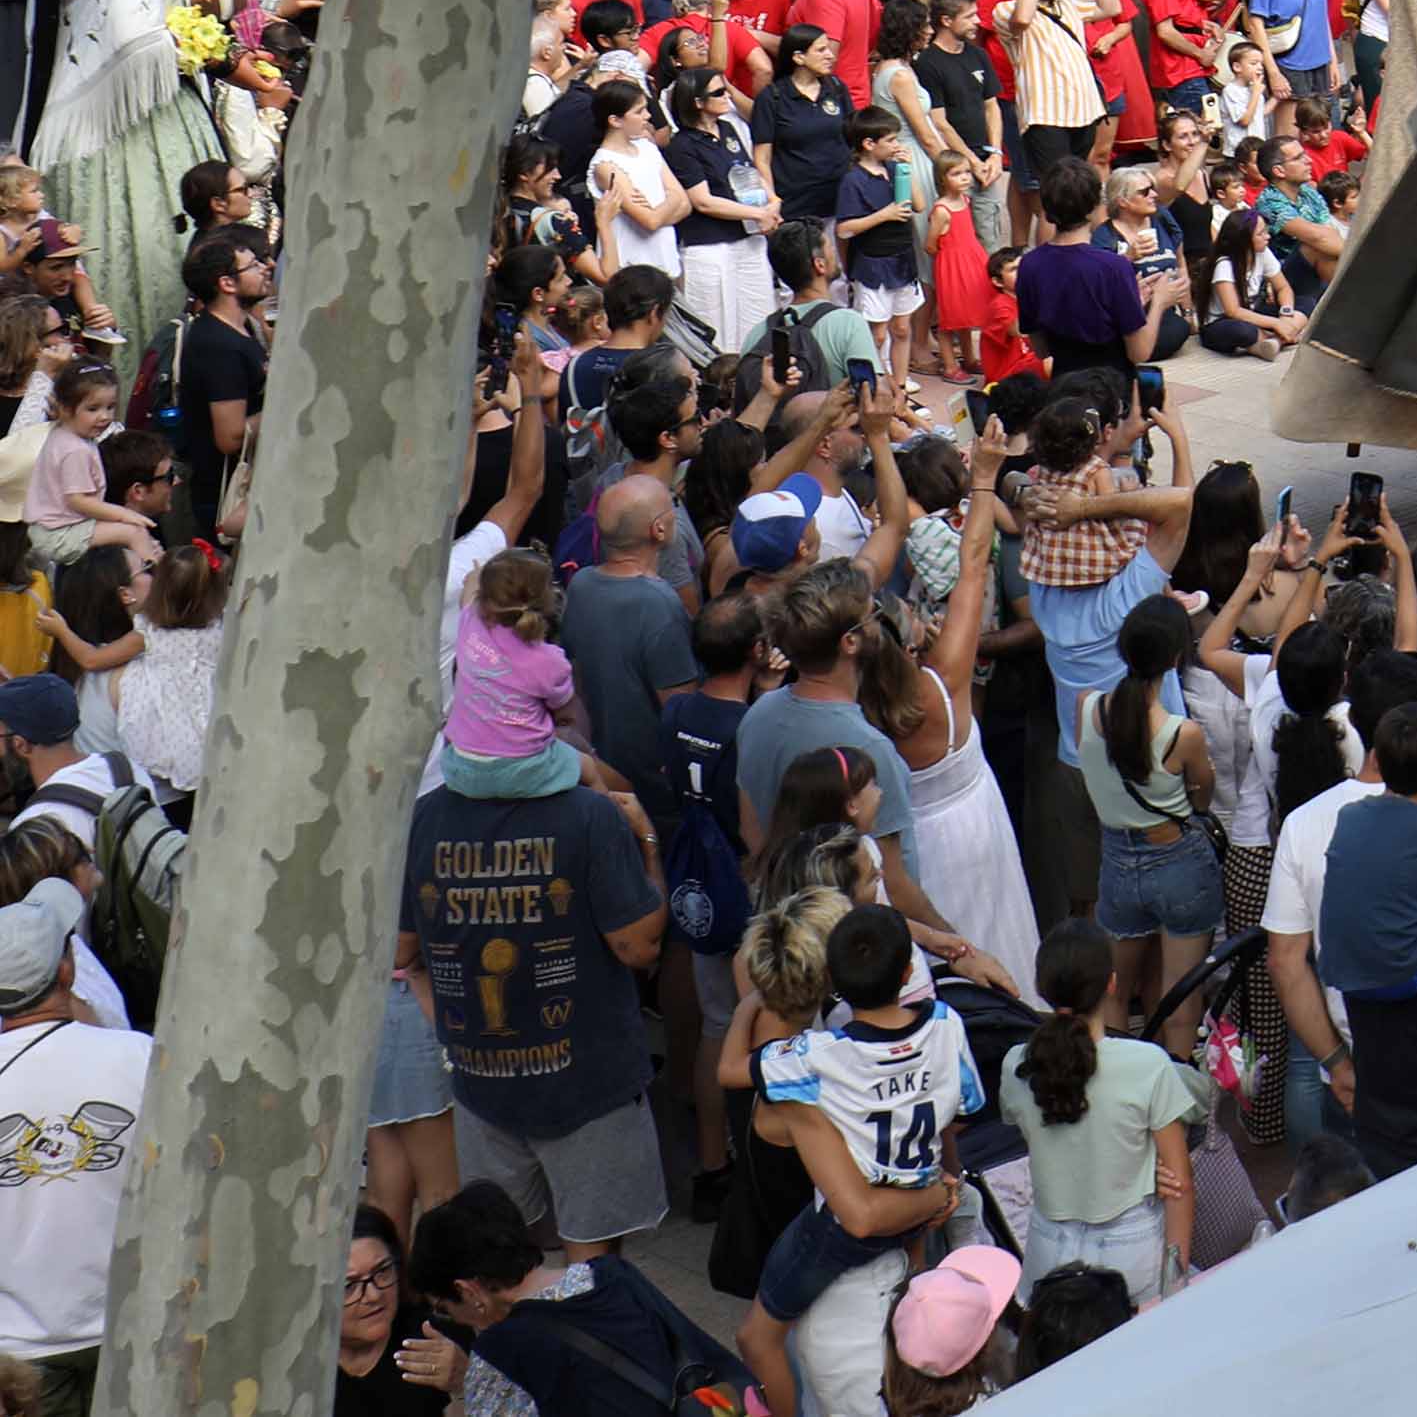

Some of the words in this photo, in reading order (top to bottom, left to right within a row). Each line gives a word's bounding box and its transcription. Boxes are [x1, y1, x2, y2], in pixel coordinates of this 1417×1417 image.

[688, 761, 702, 794] 1
[434, 837, 555, 879] GOLDEN
[446, 885, 542, 925] STATE
[872, 1071, 931, 1101] TAKE
[864, 1101, 937, 1170] 14
